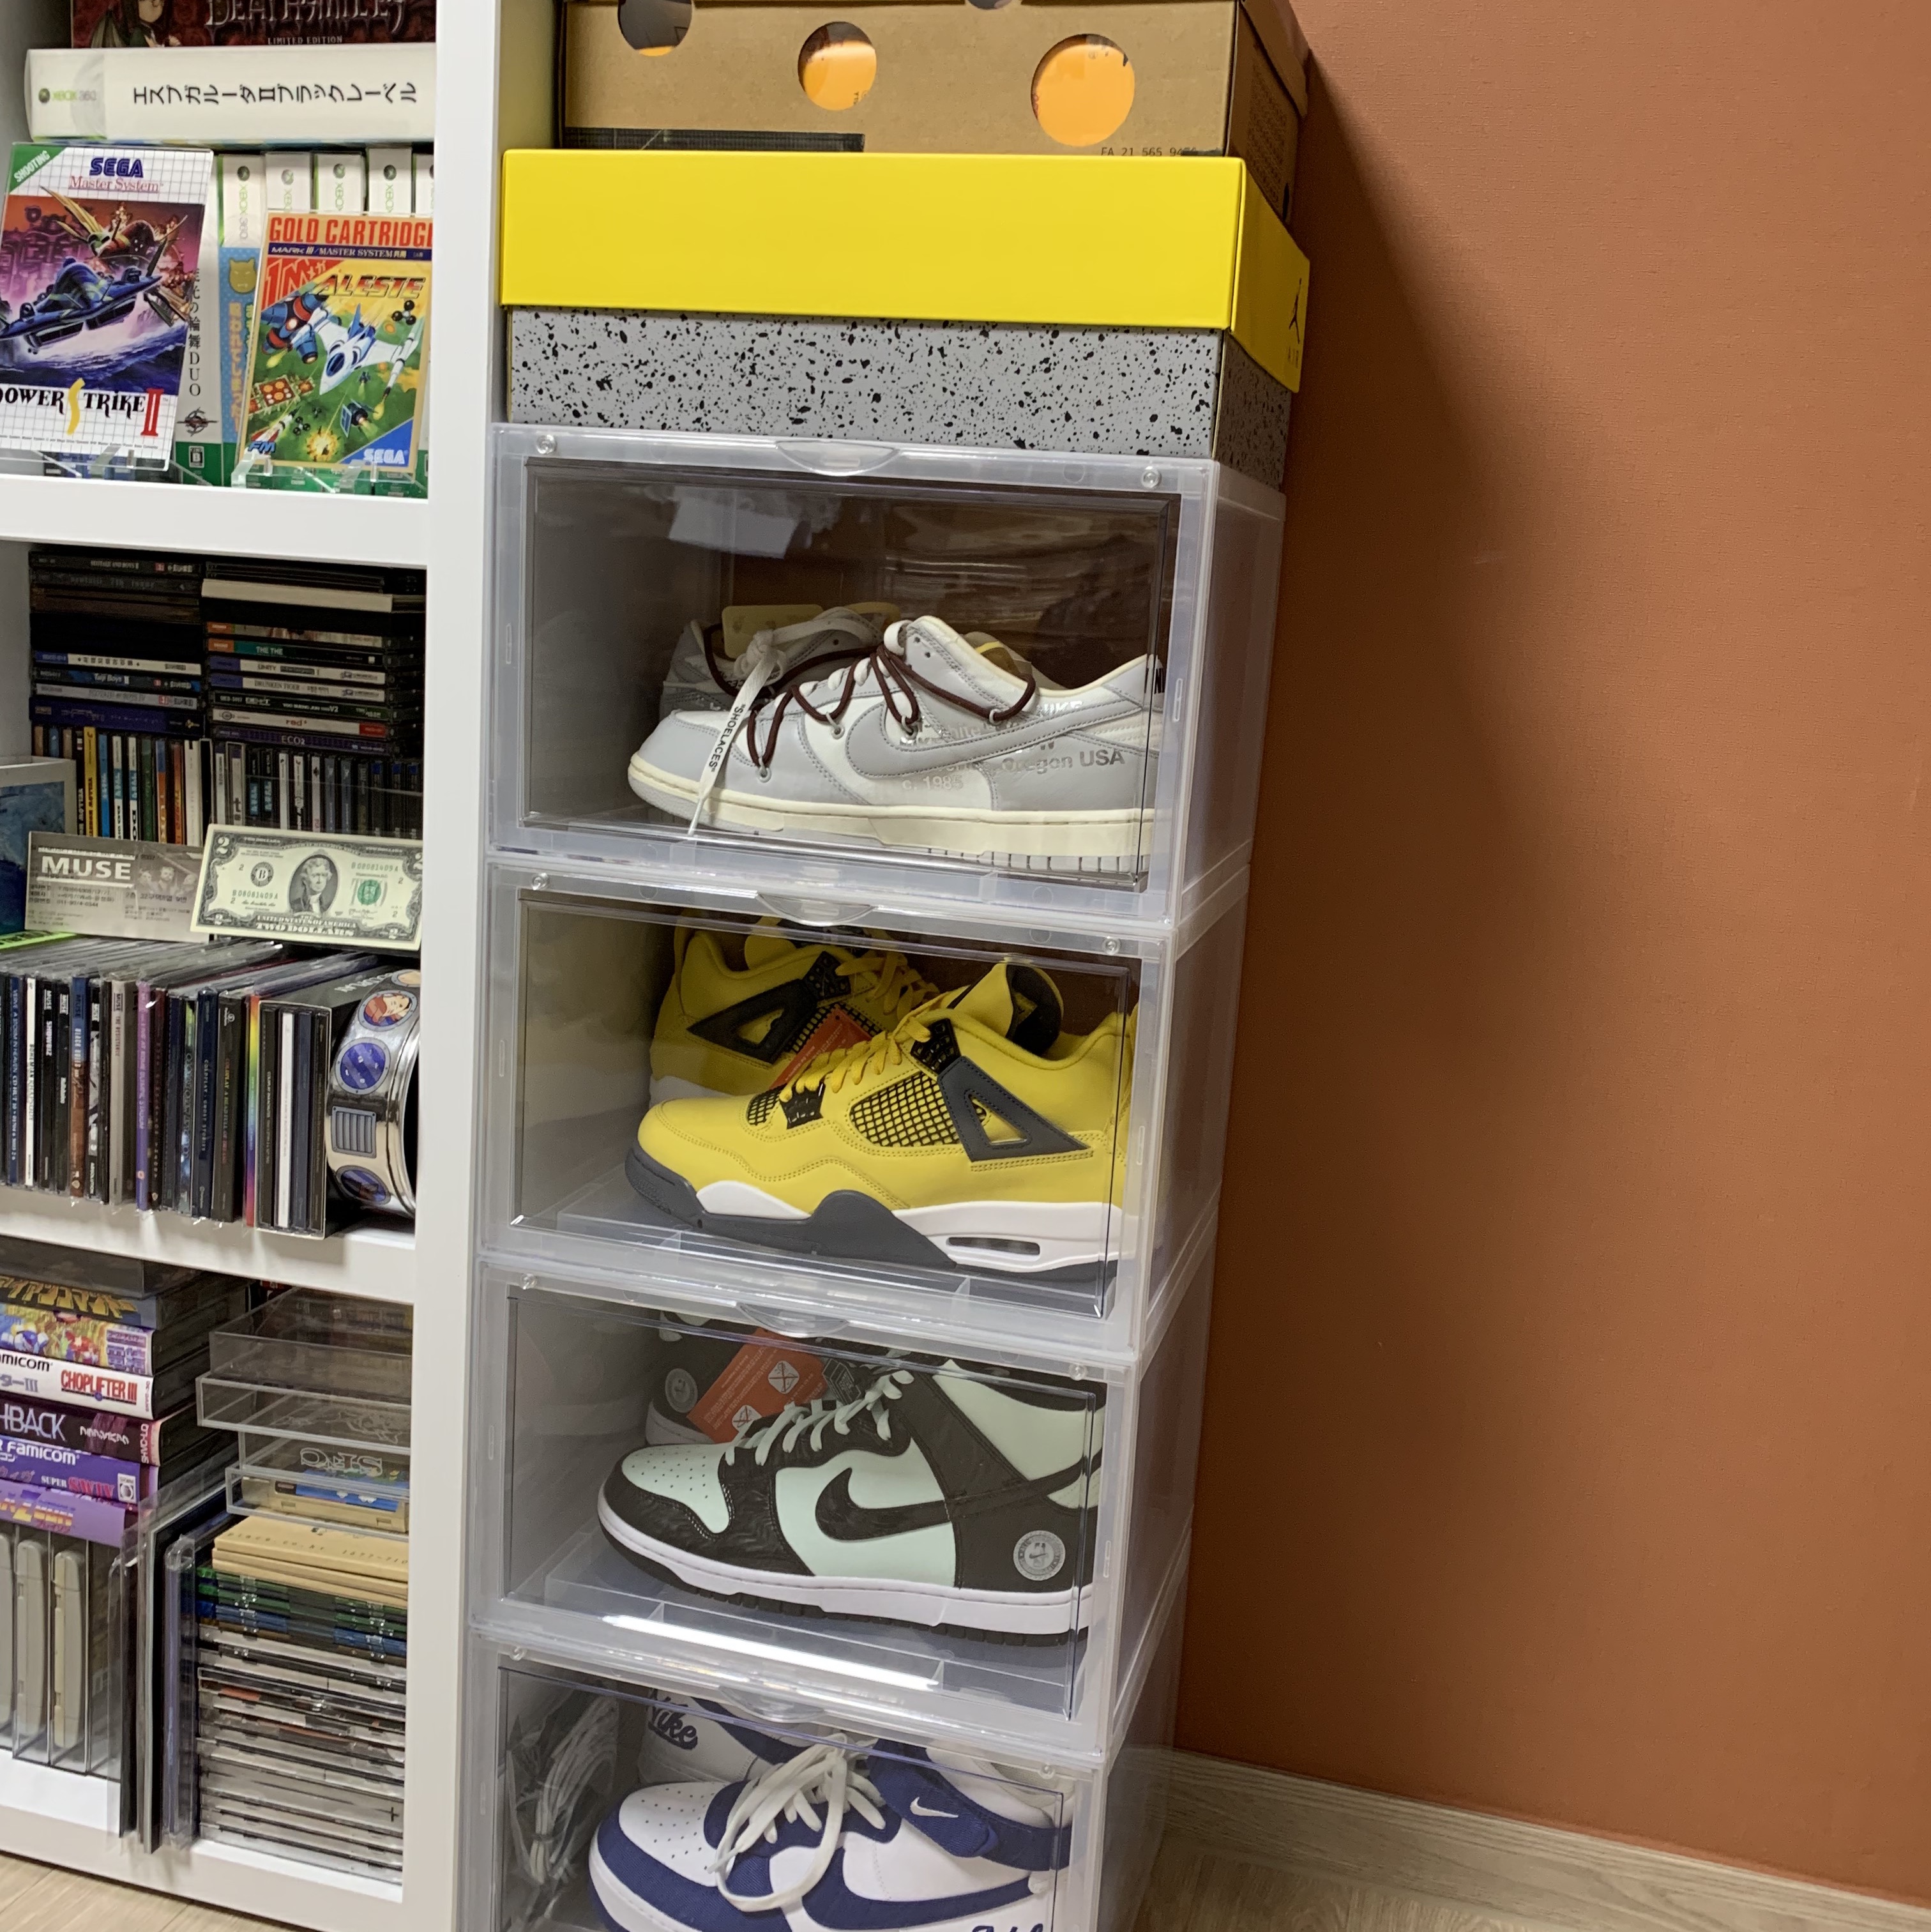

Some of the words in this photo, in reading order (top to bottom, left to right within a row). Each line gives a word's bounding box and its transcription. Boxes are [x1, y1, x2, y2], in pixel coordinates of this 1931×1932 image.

[268, 36, 303, 45] LIMITED
[307, 35, 343, 45] EDITION
[52, 90, 77, 102] XBOX
[79, 90, 96, 102] 360
[13, 150, 50, 182] SHOOTING
[89, 157, 144, 178] SEGA
[68, 176, 110, 190] Master
[114, 178, 159, 192] System
[238, 183, 248, 215] XBOX
[239, 217, 248, 240] 360
[269, 217, 320, 243] GOLD
[313, 273, 426, 299] ALESTE
[248, 441, 276, 453] FM
[363, 449, 405, 464] SEGA
[1079, 749, 1125, 767] USA
[901, 780, 918, 791] c.
[923, 776, 964, 791] 1985
[216, 837, 230, 854] 2
[42, 856, 132, 880] MUSE
[259, 870, 266, 879] B
[256, 922, 286, 932] TWO
[287, 924, 355, 937] DOLLARS
[75, 994, 84, 1018] MUSE
[74, 1027, 82, 1047] BLACK
[0, 1352, 50, 1373] micom
[61, 1369, 126, 1401] CHOPLIFTER
[126, 1381, 138, 1403] III
[41, 1475, 68, 1489] SUPER
[68, 1476, 116, 1500] SWIV
